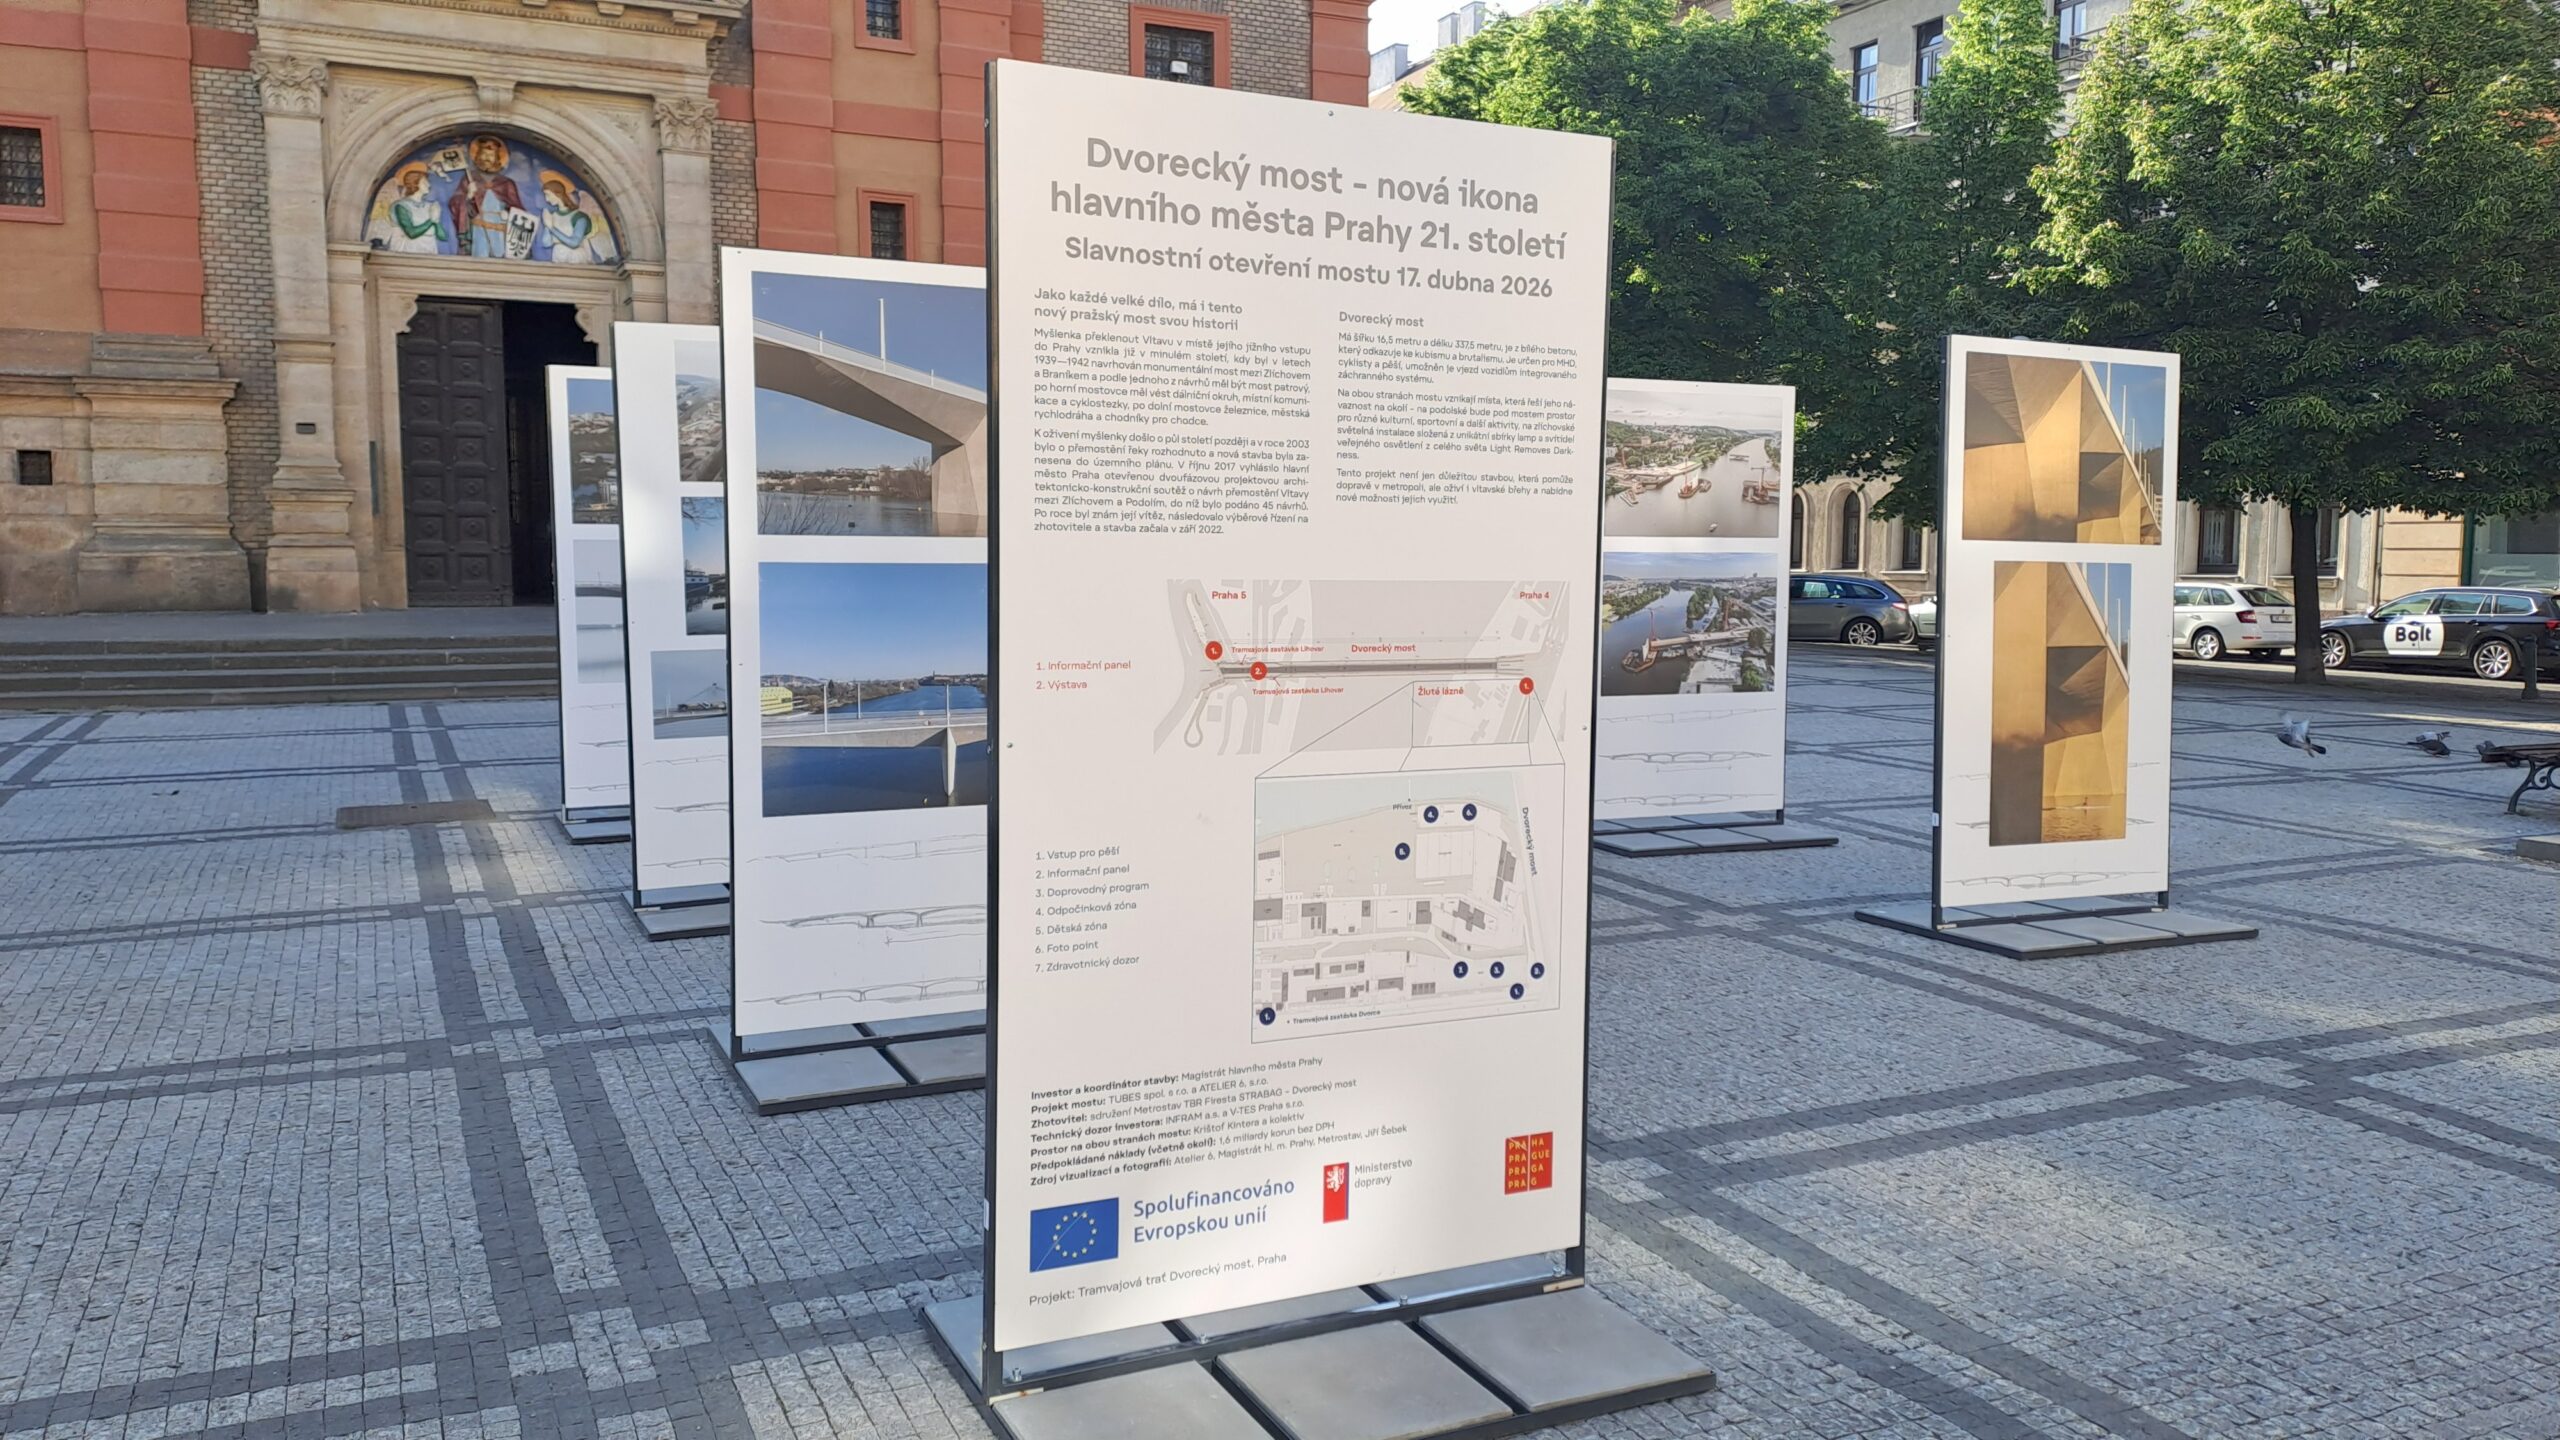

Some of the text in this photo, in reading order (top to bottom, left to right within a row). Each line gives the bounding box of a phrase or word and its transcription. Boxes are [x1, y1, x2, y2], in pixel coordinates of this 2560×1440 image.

[1087, 137, 1251, 191] Dvorecký
[1260, 165, 1343, 194] most
[1378, 176, 1449, 205] nová
[1458, 178, 1538, 214] ikona
[1051, 180, 1568, 260] hlavního města Prahy 21. století
[1065, 236, 1552, 298] Slavnostní otevření mostu 17. dubna 2026
[1034, 288, 1243, 314] Jako každé velké dílo, má i tento
[1034, 306, 1067, 321] nový
[1070, 308, 1120, 325] pražský
[1123, 314, 1156, 325] most
[1160, 317, 1189, 327] svou
[1339, 311, 1424, 328] Dvorecký most
[1034, 328, 1081, 340] Myšlenka
[1085, 331, 1139, 344] překlenout
[1142, 335, 1174, 346] Vltavu
[1186, 338, 1213, 349] místě
[1216, 340, 1243, 352] jejího
[1246, 342, 1277, 353] jižního
[1280, 346, 1311, 356] vstupu
[1091, 359, 1142, 370] navrhován
[1143, 364, 1213, 374] monumentální
[1214, 368, 1238, 376] most
[1240, 369, 1262, 377] mezi
[1264, 368, 1311, 380] Zlíchovem
[1338, 358, 1372, 370] cyklisty
[1382, 360, 1403, 370] pěší,
[1405, 362, 1444, 372] umožněn
[1456, 365, 1479, 375] vjezd
[1481, 366, 1517, 376] vozidlům
[1519, 368, 1577, 380] integrovaného
[1338, 370, 1434, 384] záchranného systému.
[1034, 468, 1067, 478] město
[1072, 469, 1100, 480] Praha
[1104, 471, 1155, 481] otevřenou
[1159, 472, 1220, 483] dvoufázovou
[1224, 475, 1279, 486] projektovou
[1035, 482, 1151, 494] tektonicko-konstrukční
[1154, 485, 1186, 495] soutěž
[1197, 486, 1223, 496] návrh
[1225, 487, 1279, 498] přemostění
[1280, 489, 1309, 500] Vltavy
[1336, 493, 1458, 506] nové možnosti jejich využití.
[1212, 591, 1238, 599] Praha
[2396, 625, 2431, 642] Bolt
[1351, 644, 1416, 654] Dvorecký most
[1036, 660, 1131, 671] 1. Informační panel
[1036, 680, 1088, 692] 2. Výstava
[1418, 685, 1464, 696] Žluté lázně
[1522, 807, 1538, 876] Dvorecký most
[1036, 846, 1120, 861] 1. Vstup pro pěší
[1036, 864, 1130, 879] 2. Informační panel
[1035, 883, 1150, 898] 3. Doprovodný program
[1035, 900, 1137, 916] 4. Odpočinková zóna
[1035, 922, 1108, 935] 5. Dětská zóna
[1035, 941, 1098, 954] 6. Foto point
[1035, 956, 1139, 973] 7. Zdravotnický dozor
[1031, 1088, 1073, 1100] Investor
[1083, 1080, 1141, 1093] koordinátor
[1144, 1074, 1179, 1086] stavby:
[1182, 1068, 1226, 1081] Magistrát
[1228, 1064, 1266, 1075] hlavního
[1268, 1061, 1296, 1070] města
[1298, 1057, 1322, 1067] Prahy
[1354, 1159, 1412, 1175] Ministerstvo
[1354, 1175, 1392, 1189] dopravy
[1134, 1179, 1294, 1219] Spolufinancováno
[1134, 1204, 1267, 1243] Evropskou unií
[1029, 1253, 1286, 1306] Projekt: Tramvajová trať Dvorecký most, Praha
